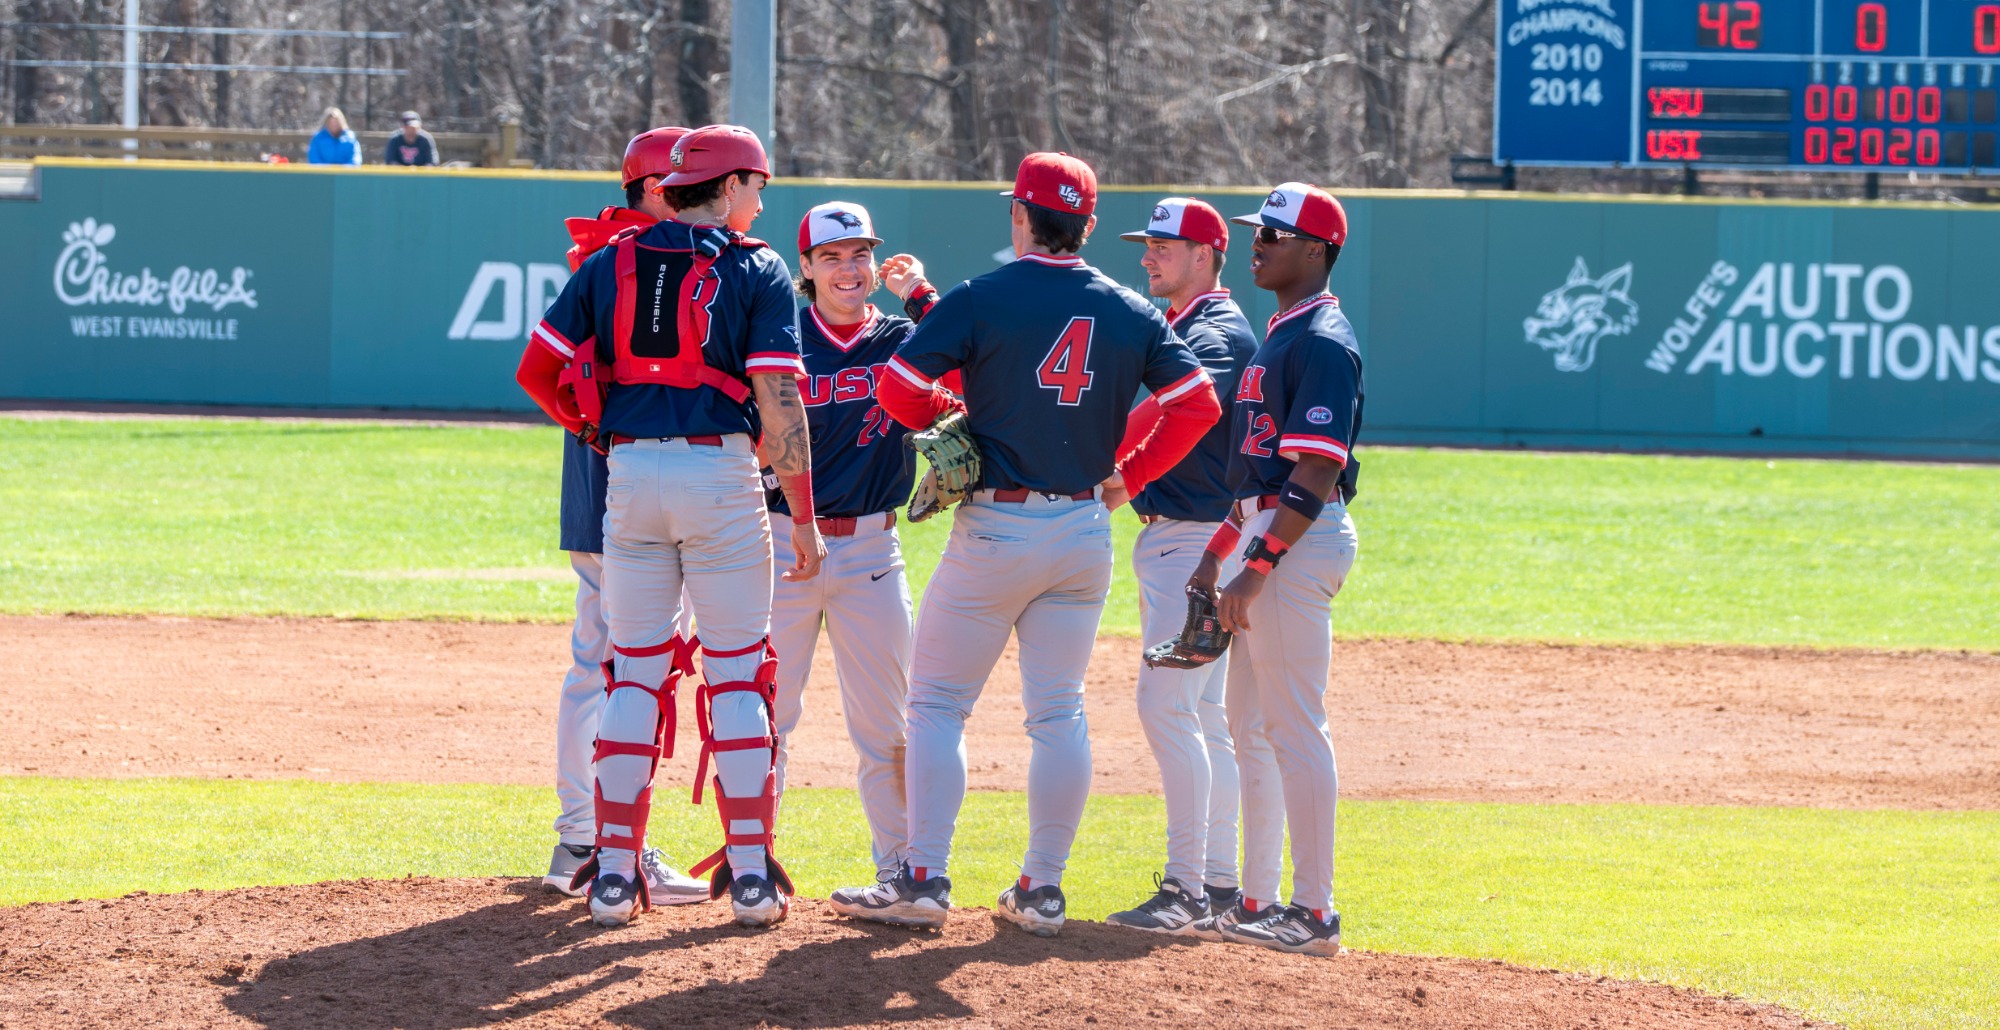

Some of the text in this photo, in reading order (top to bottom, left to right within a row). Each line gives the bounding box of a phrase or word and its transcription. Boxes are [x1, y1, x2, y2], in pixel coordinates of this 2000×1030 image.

[1507, 8, 1626, 50] CHAMPIONS
[1699, 1, 1760, 49] 42
[1856, 3, 1886, 52] 0
[1974, 5, 2000, 54] 0
[1530, 42, 1603, 72] 2010
[1529, 77, 1603, 106] 2014
[1648, 88, 1703, 118] YSU
[1647, 130, 1702, 160] USI
[1059, 184, 1083, 210] USI
[54, 234, 258, 314] Chick-fil-A
[652, 264, 667, 333] EVOSHIELD
[1644, 260, 1912, 374] WOLFE'S AUTO
[70, 315, 239, 340] WEST EVANSVILLE
[1036, 316, 1094, 406] 4
